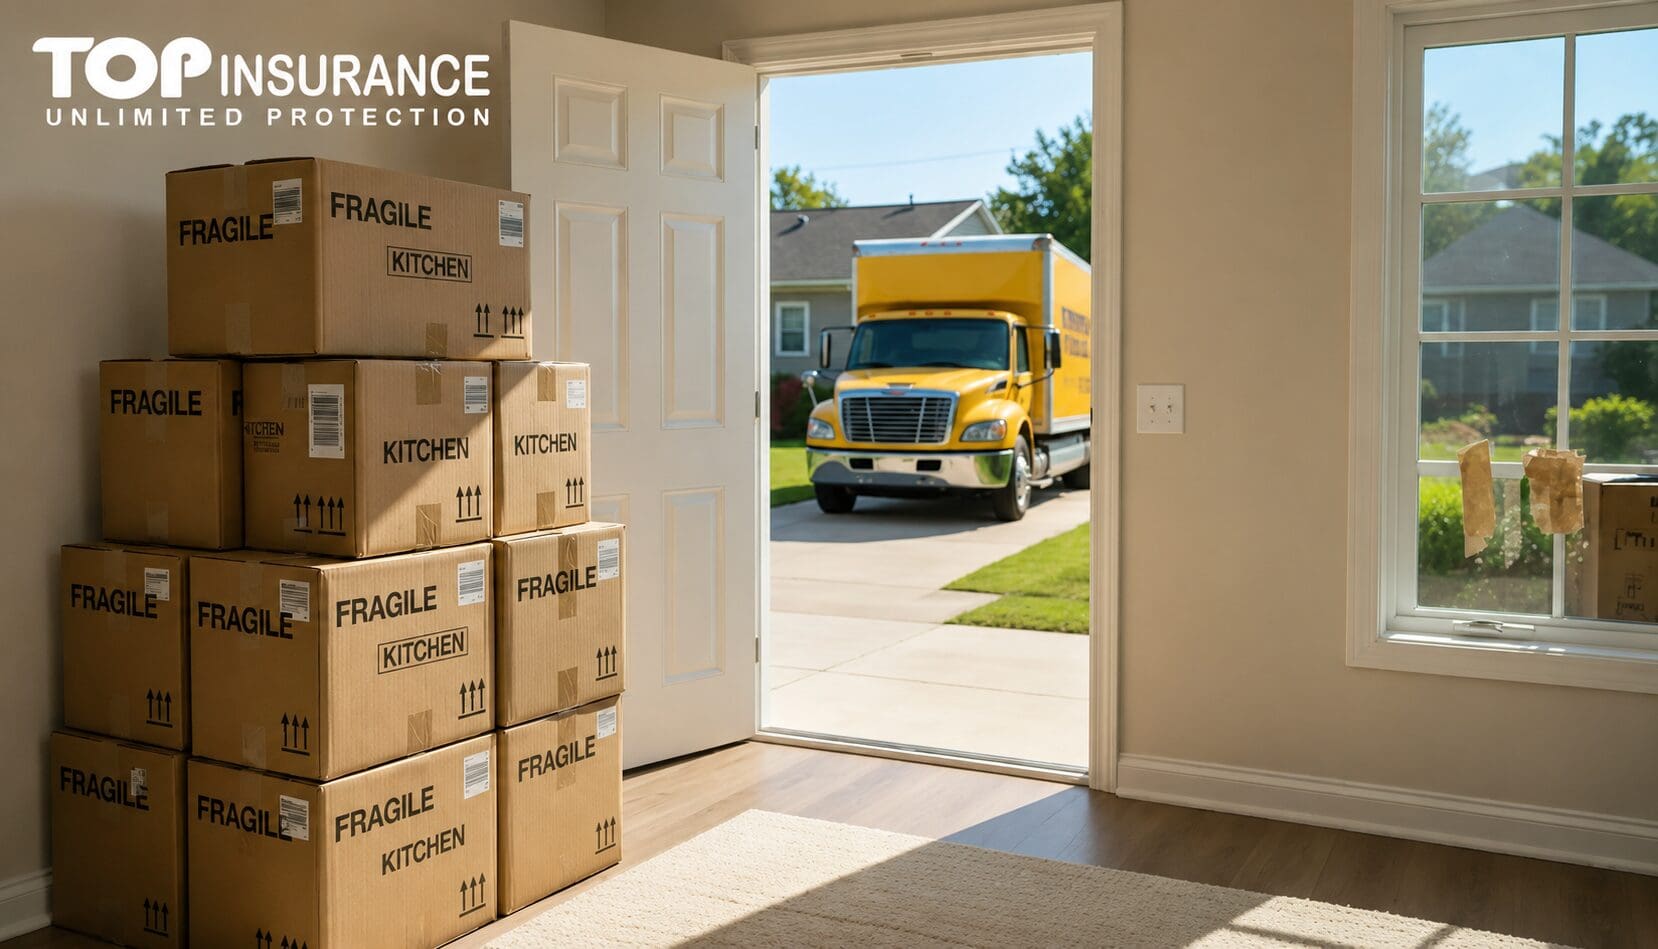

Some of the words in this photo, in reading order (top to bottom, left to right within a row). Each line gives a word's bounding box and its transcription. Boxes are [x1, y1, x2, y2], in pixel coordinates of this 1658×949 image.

[179, 213, 274, 247] FRAGILE
[330, 192, 433, 231] FRAGILE
[391, 250, 470, 280] KITCHEN
[110, 389, 203, 417] FRAGILE
[383, 437, 470, 465] KITCHEN
[514, 432, 578, 457] KITCHEN
[70, 583, 159, 621] FRAGILE
[517, 565, 598, 602] FRAGILE
[198, 602, 294, 641] FRAGILE
[336, 585, 438, 628] FRAGILE
[382, 631, 465, 669] KITCHEN
[518, 735, 597, 783] FRAGILE
[60, 766, 150, 811] FRAGILE
[335, 785, 436, 843] FRAGILE
[381, 824, 466, 876] KITCHEN
